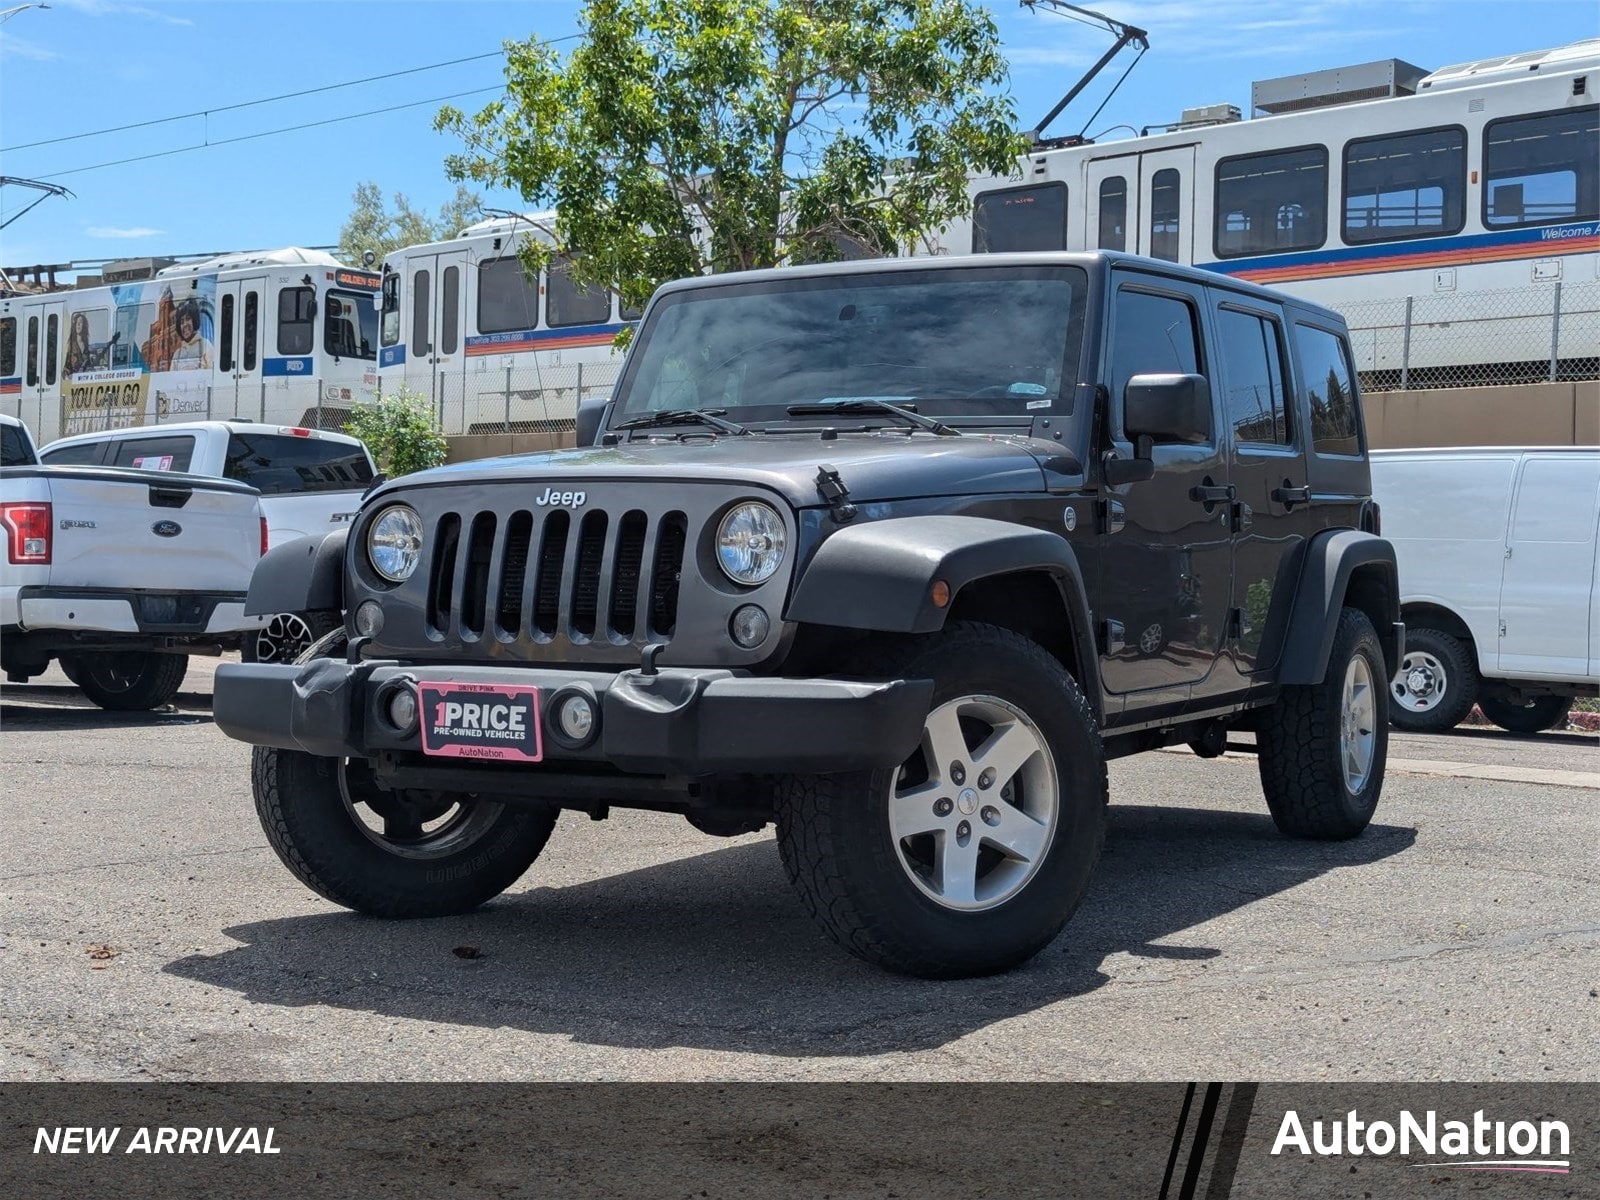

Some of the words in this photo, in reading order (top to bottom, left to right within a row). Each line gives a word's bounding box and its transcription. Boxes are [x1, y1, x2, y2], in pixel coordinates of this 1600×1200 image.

[1541, 227, 1592, 239] Welcome
[70, 386, 94, 409] YOU
[95, 384, 120, 407] CAN
[121, 383, 140, 406] GO
[172, 399, 204, 412] Denver
[535, 487, 586, 509] Jeep
[433, 726, 482, 737] PRE-OWNED
[484, 730, 526, 740] VEHICLES
[459, 747, 504, 758] AutoNation
